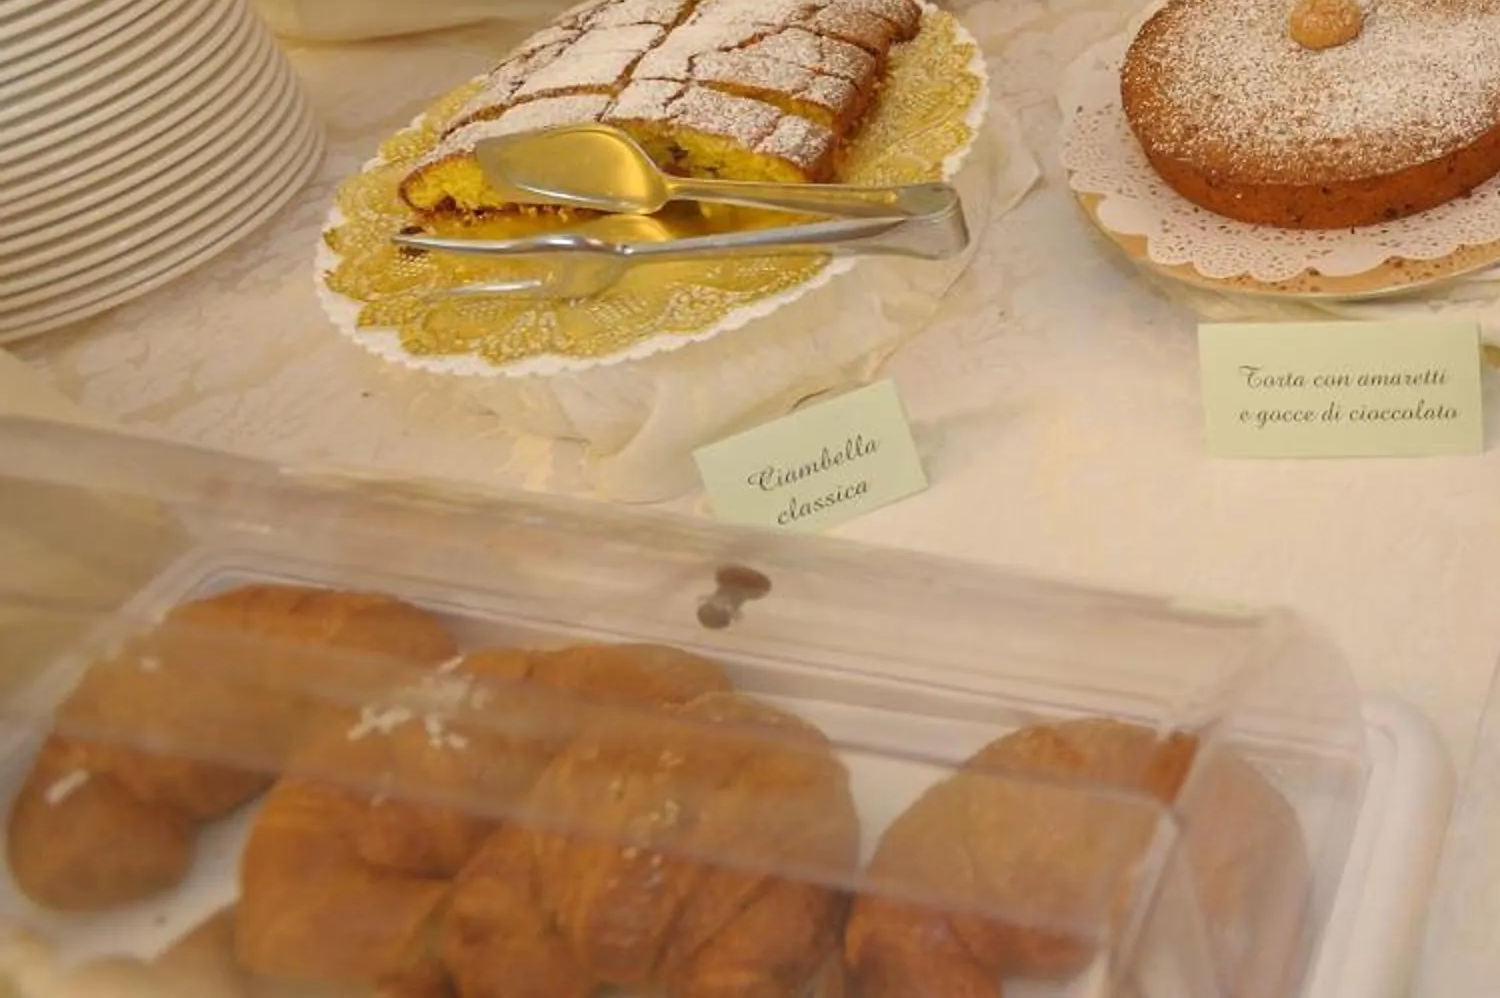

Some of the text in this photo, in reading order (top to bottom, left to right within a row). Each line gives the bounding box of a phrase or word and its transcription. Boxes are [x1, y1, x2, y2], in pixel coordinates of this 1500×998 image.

[1238, 364, 1448, 390] Torta con amaretti
[1238, 399, 1458, 429] e gocce di cioccolato
[747, 433, 880, 492] Ciambella
[777, 477, 871, 526] classica
